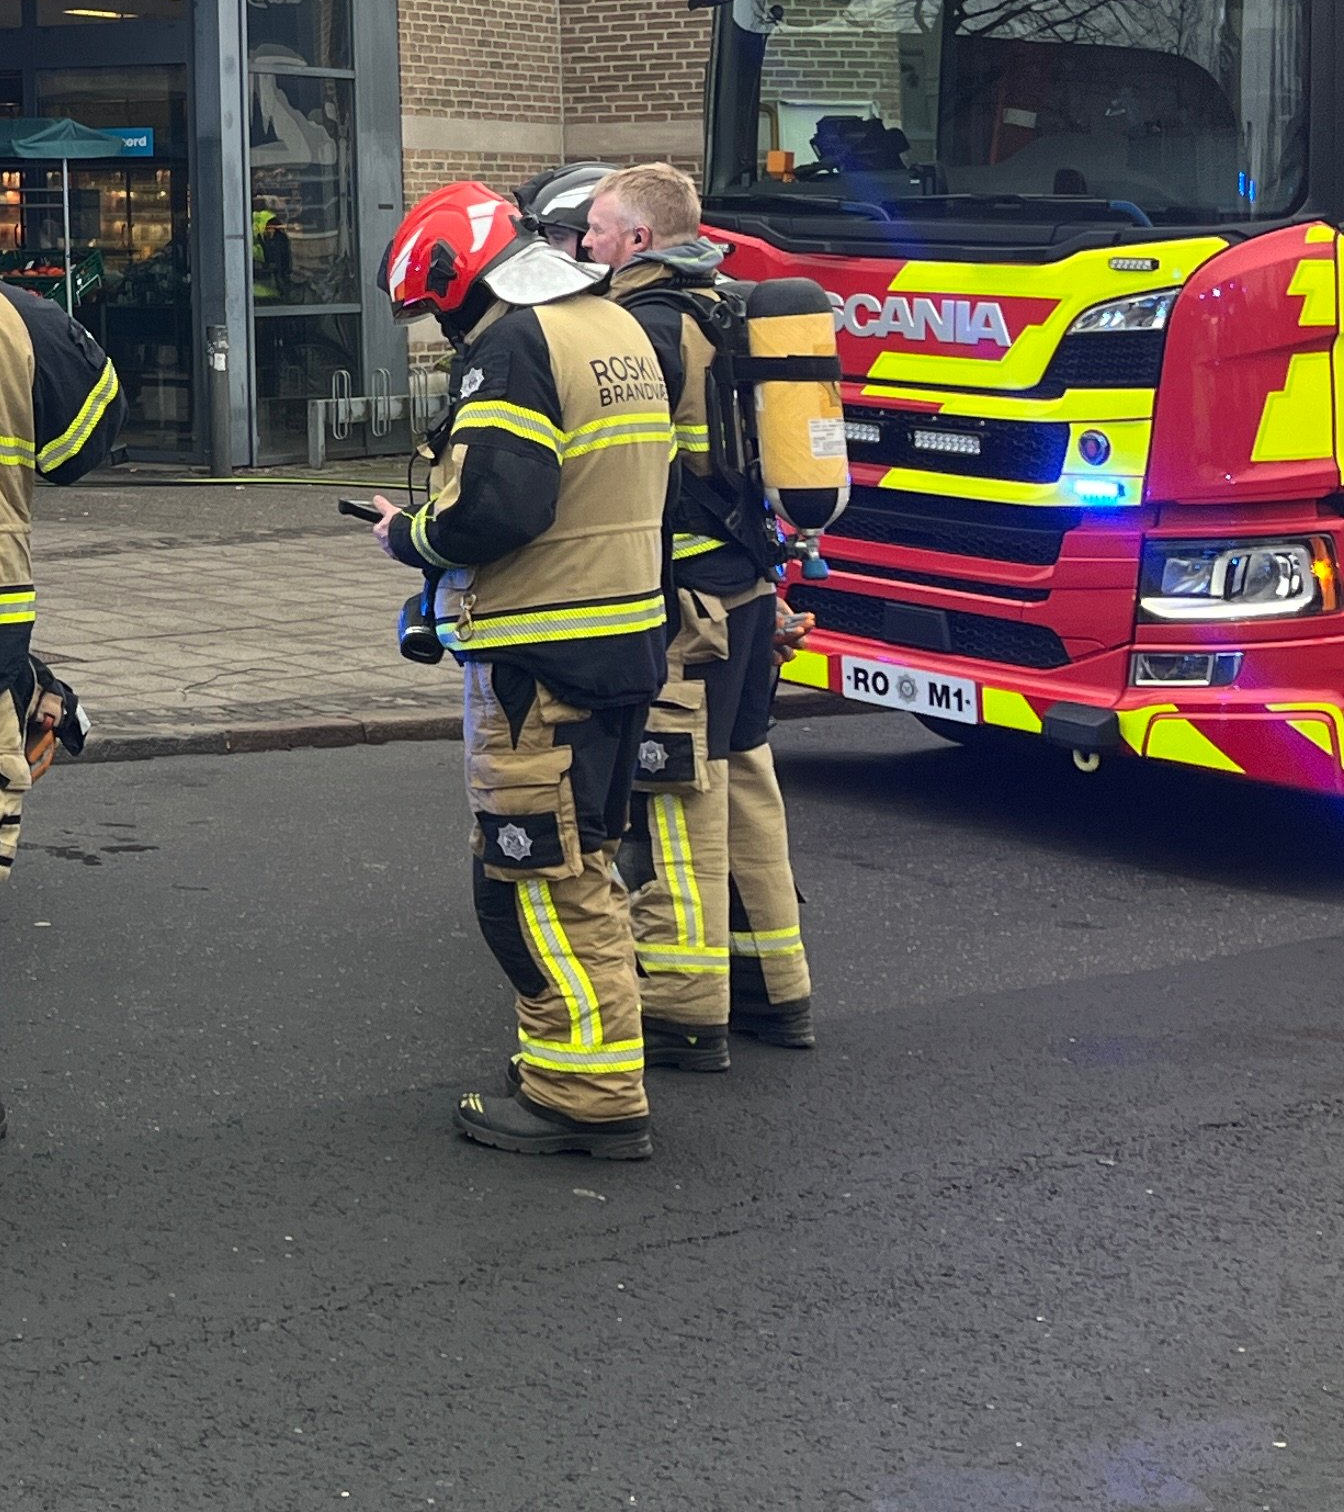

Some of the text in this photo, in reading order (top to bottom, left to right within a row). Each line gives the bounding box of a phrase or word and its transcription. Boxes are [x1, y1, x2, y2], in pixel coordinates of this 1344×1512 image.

[825, 291, 1012, 348] SCANIA
[589, 355, 665, 386] ROSKIL
[853, 666, 964, 712] RO M1
